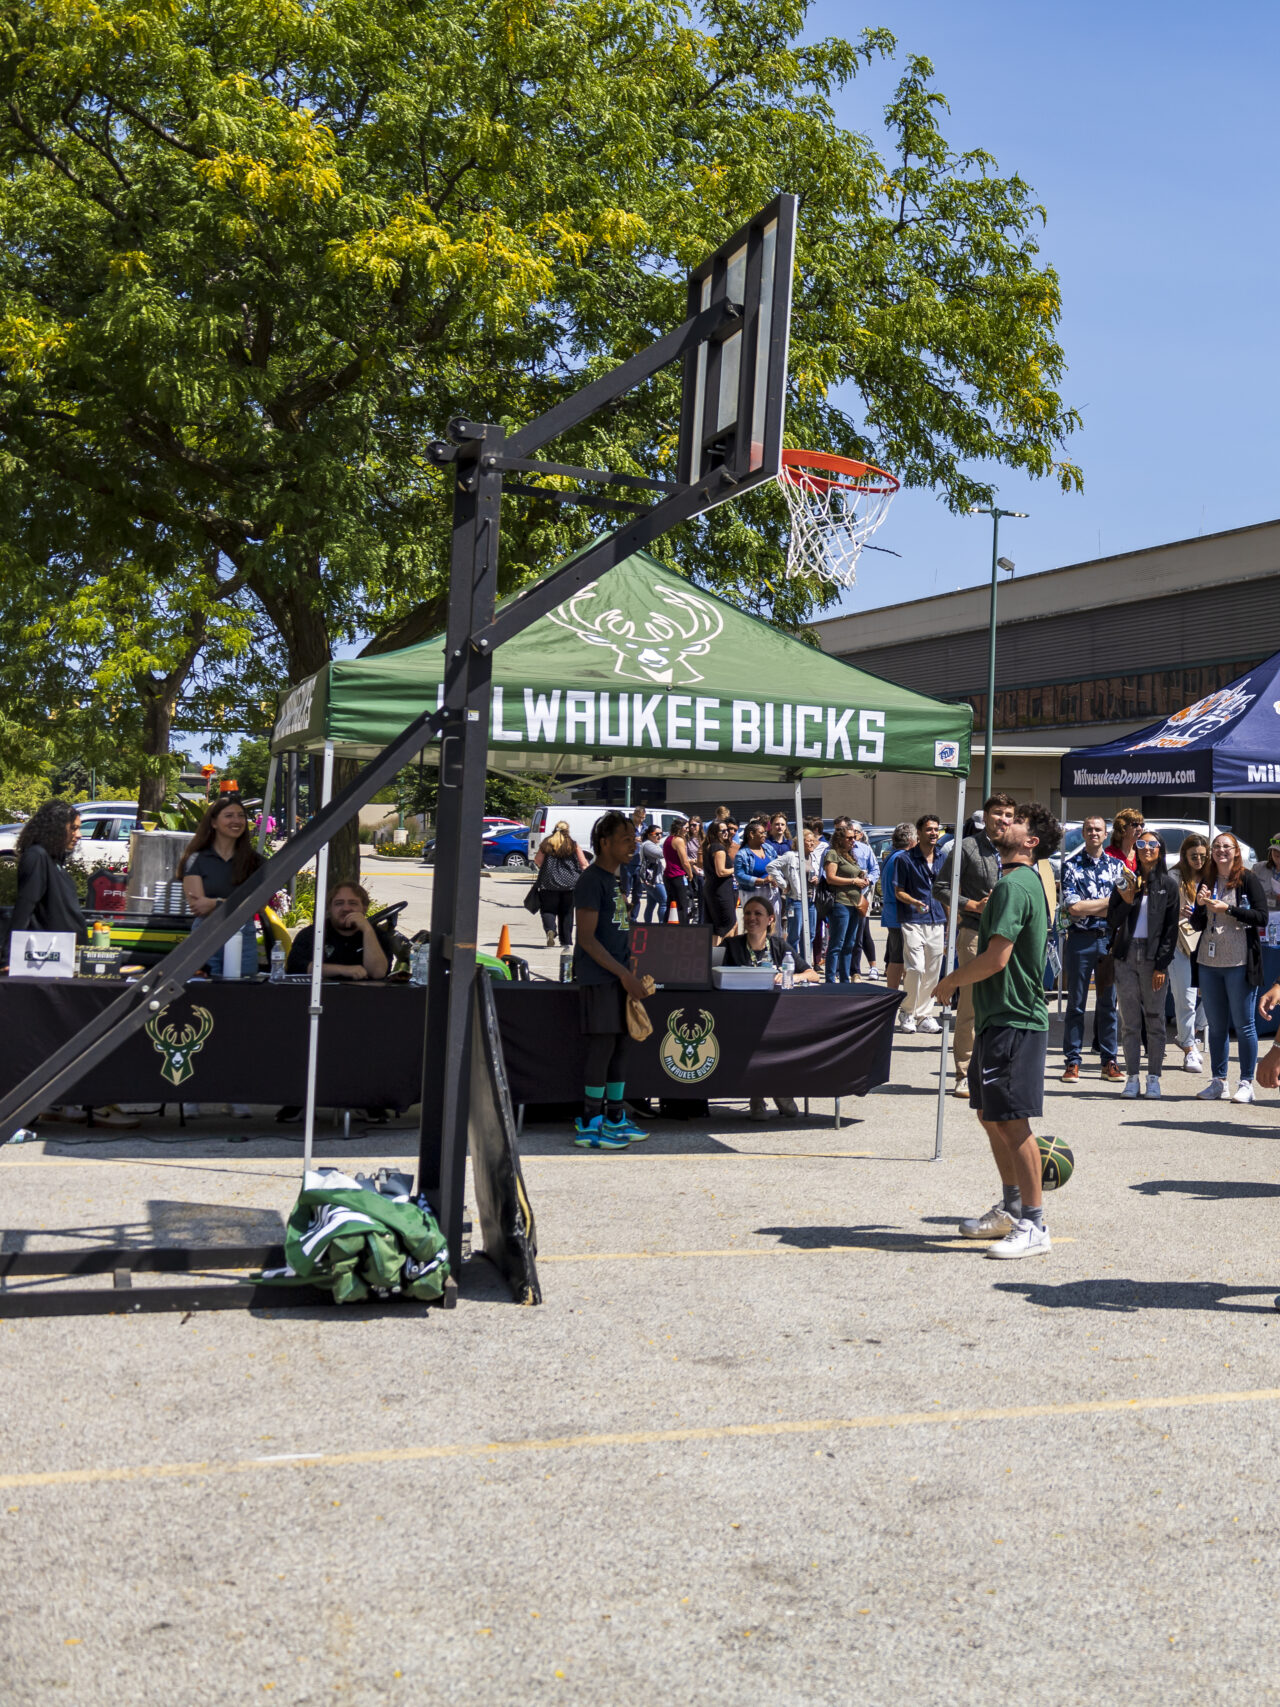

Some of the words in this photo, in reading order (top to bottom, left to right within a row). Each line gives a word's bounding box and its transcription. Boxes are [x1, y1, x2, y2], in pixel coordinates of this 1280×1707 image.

[437, 684, 720, 752] LWAUKEE
[732, 700, 887, 763] BUCKS
[1073, 768, 1196, 786] MilwaukeeDowntown.com
[664, 1056, 696, 1079] MILWAUKEE
[696, 1056, 715, 1077] BUCKS
